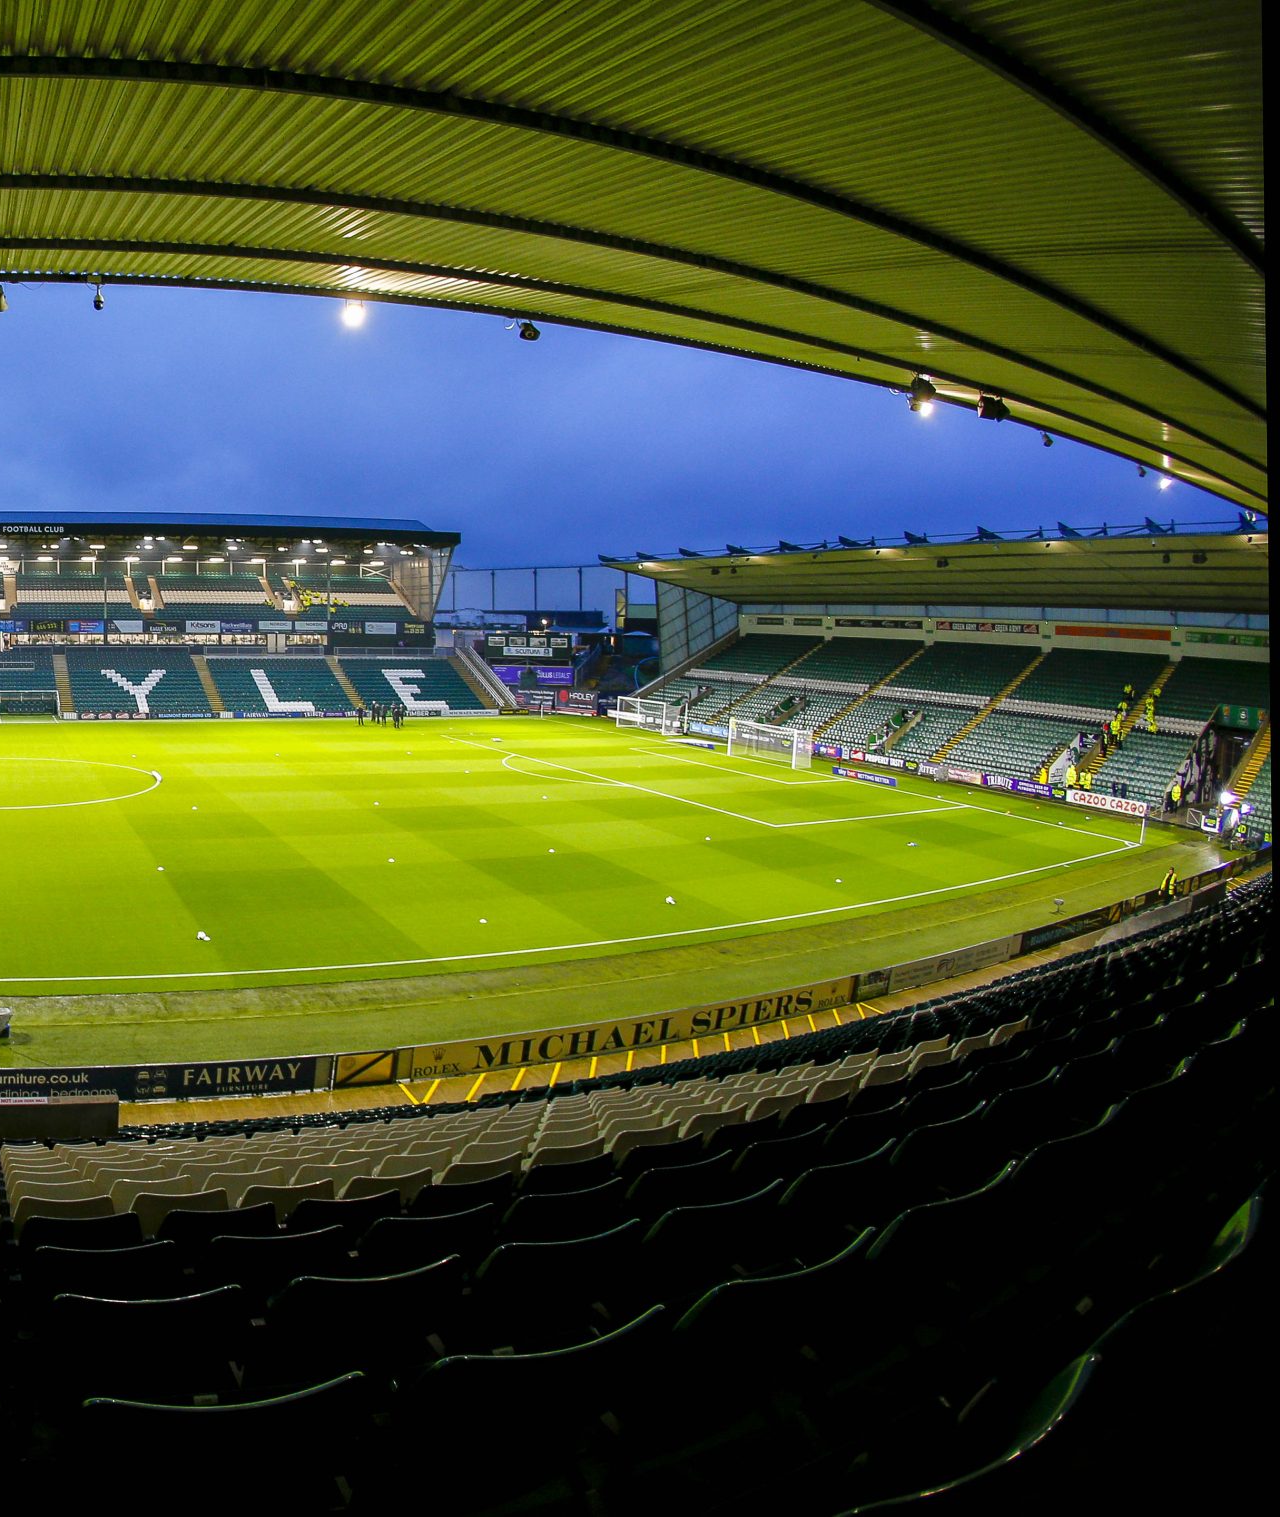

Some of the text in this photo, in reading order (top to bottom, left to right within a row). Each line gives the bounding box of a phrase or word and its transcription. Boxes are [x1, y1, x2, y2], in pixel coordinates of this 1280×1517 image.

[2, 526, 42, 534] FOOTBALL
[44, 526, 65, 534] CLUB
[190, 622, 216, 630] Kitsons
[570, 690, 595, 700] HADLEY
[864, 752, 904, 768] PROPERLY TASTY
[838, 768, 846, 776] sky
[848, 770, 856, 778] bet
[986, 775, 1013, 790] TRIBUTE
[1073, 792, 1144, 814] CAZOO CAZOO
[818, 994, 847, 1008] ROLEX
[475, 990, 814, 1070] MICHAEL SPIERS
[183, 1062, 301, 1086] FAIRWAY
[413, 1062, 461, 1078] ROLEX
[50, 1086, 118, 1097] bedrooms
[216, 1084, 269, 1093] FURNITURE
